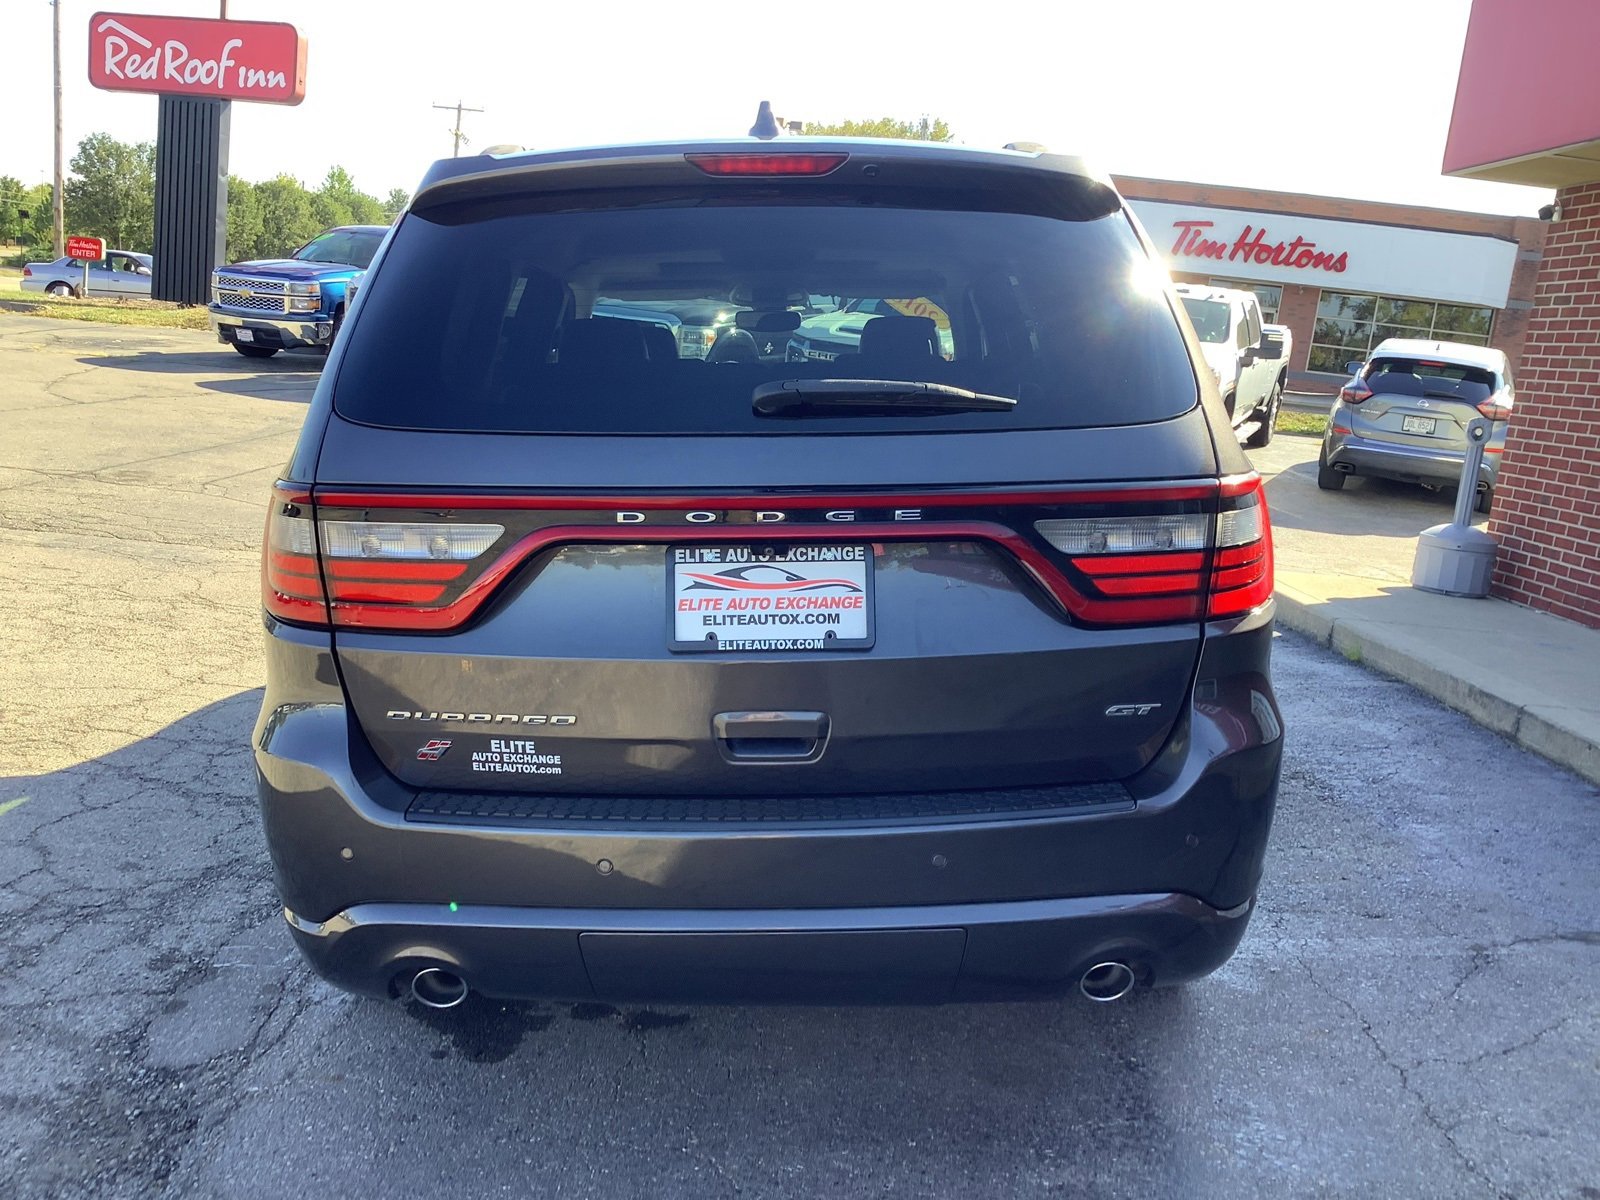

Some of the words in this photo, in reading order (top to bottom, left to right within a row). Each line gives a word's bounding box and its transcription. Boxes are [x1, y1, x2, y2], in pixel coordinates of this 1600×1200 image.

[1172, 220, 1228, 260] Tim
[1228, 225, 1348, 273] Hortons
[71, 249, 96, 258] ENTER
[616, 509, 922, 523] DODGE
[675, 548, 721, 563] ELITE
[776, 546, 865, 561] XCHANGE
[678, 597, 723, 612] ELITE
[726, 597, 771, 611] AUTO
[774, 596, 864, 610] EXCHANGE
[702, 613, 841, 626] ELITEAUTOX.COM
[717, 639, 825, 651] ELITEAUTOX.COM
[1105, 703, 1162, 716] GT
[386, 710, 577, 725] DURANGO
[490, 739, 536, 754] ELITE
[471, 752, 500, 762] AUTO
[503, 753, 561, 765] EXCHANGE
[472, 762, 562, 774] ELITEAUTOX.com
